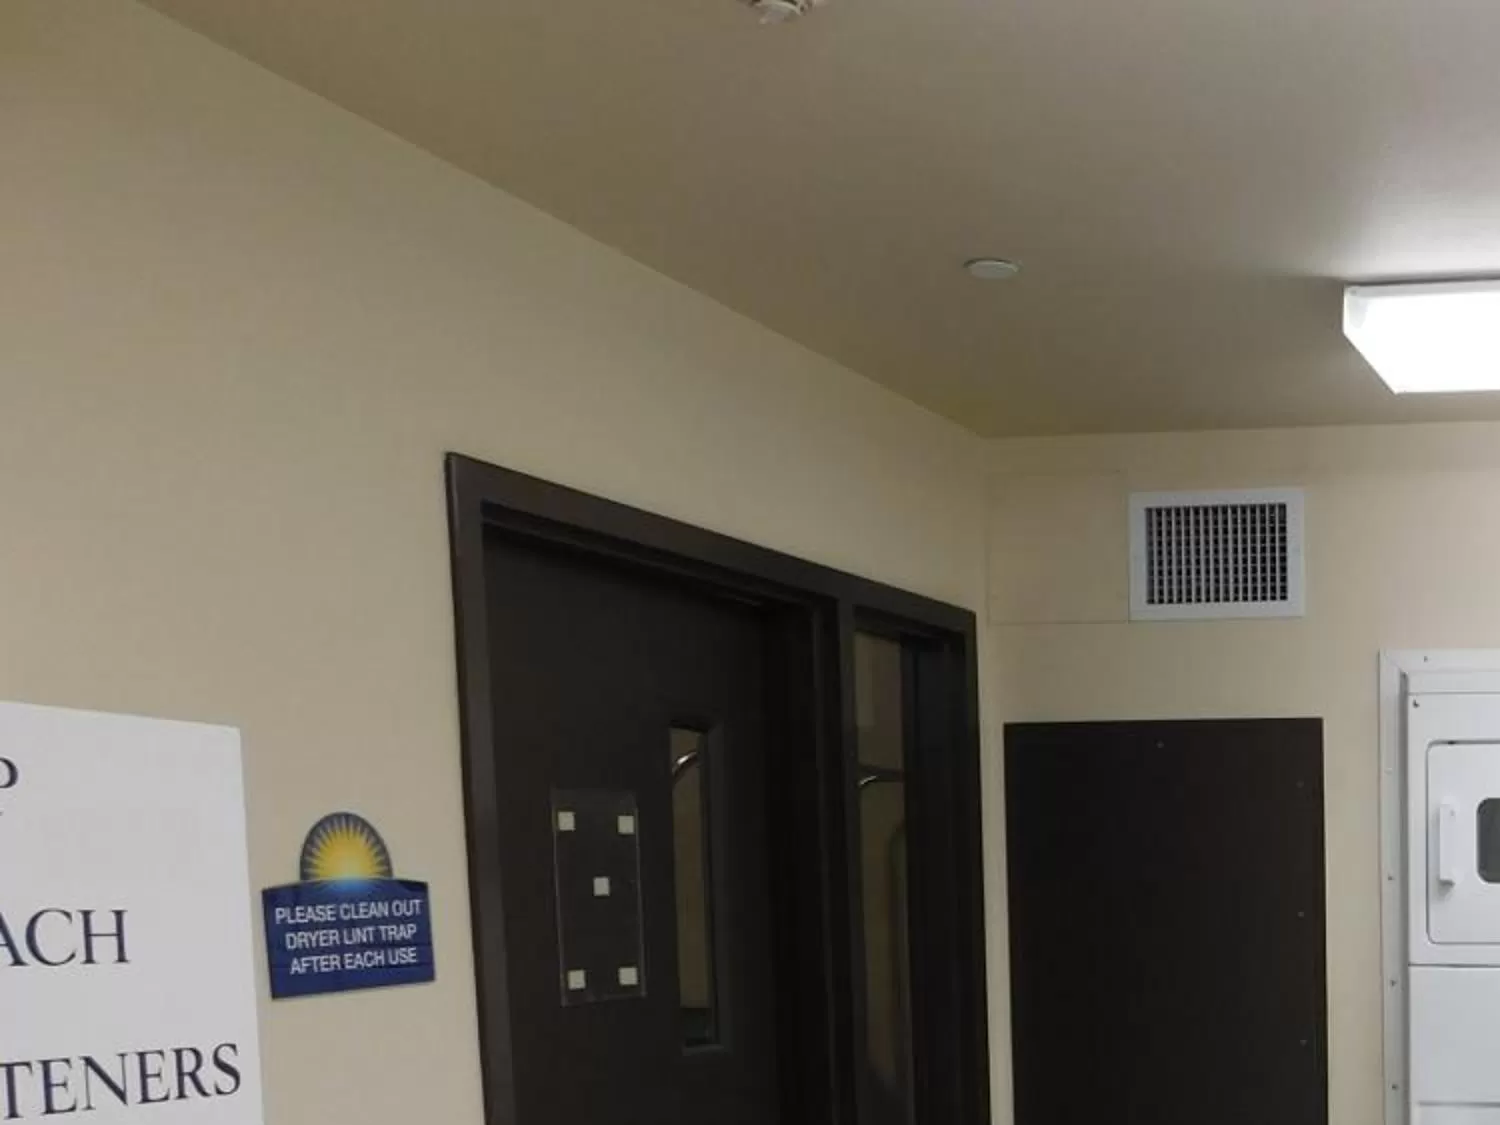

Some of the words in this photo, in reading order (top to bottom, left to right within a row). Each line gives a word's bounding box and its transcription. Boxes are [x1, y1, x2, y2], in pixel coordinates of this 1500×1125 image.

[275, 903, 337, 925] PLEASE
[339, 901, 389, 921] CLEAN
[391, 899, 423, 917] OUT
[285, 929, 340, 950] DRYER
[343, 927, 376, 945] LINT
[379, 924, 417, 942] TRAP
[290, 955, 341, 975] AFTER
[344, 951, 385, 970] EACH
[388, 947, 417, 965] USE
[0, 1042, 241, 1121] TENERS
